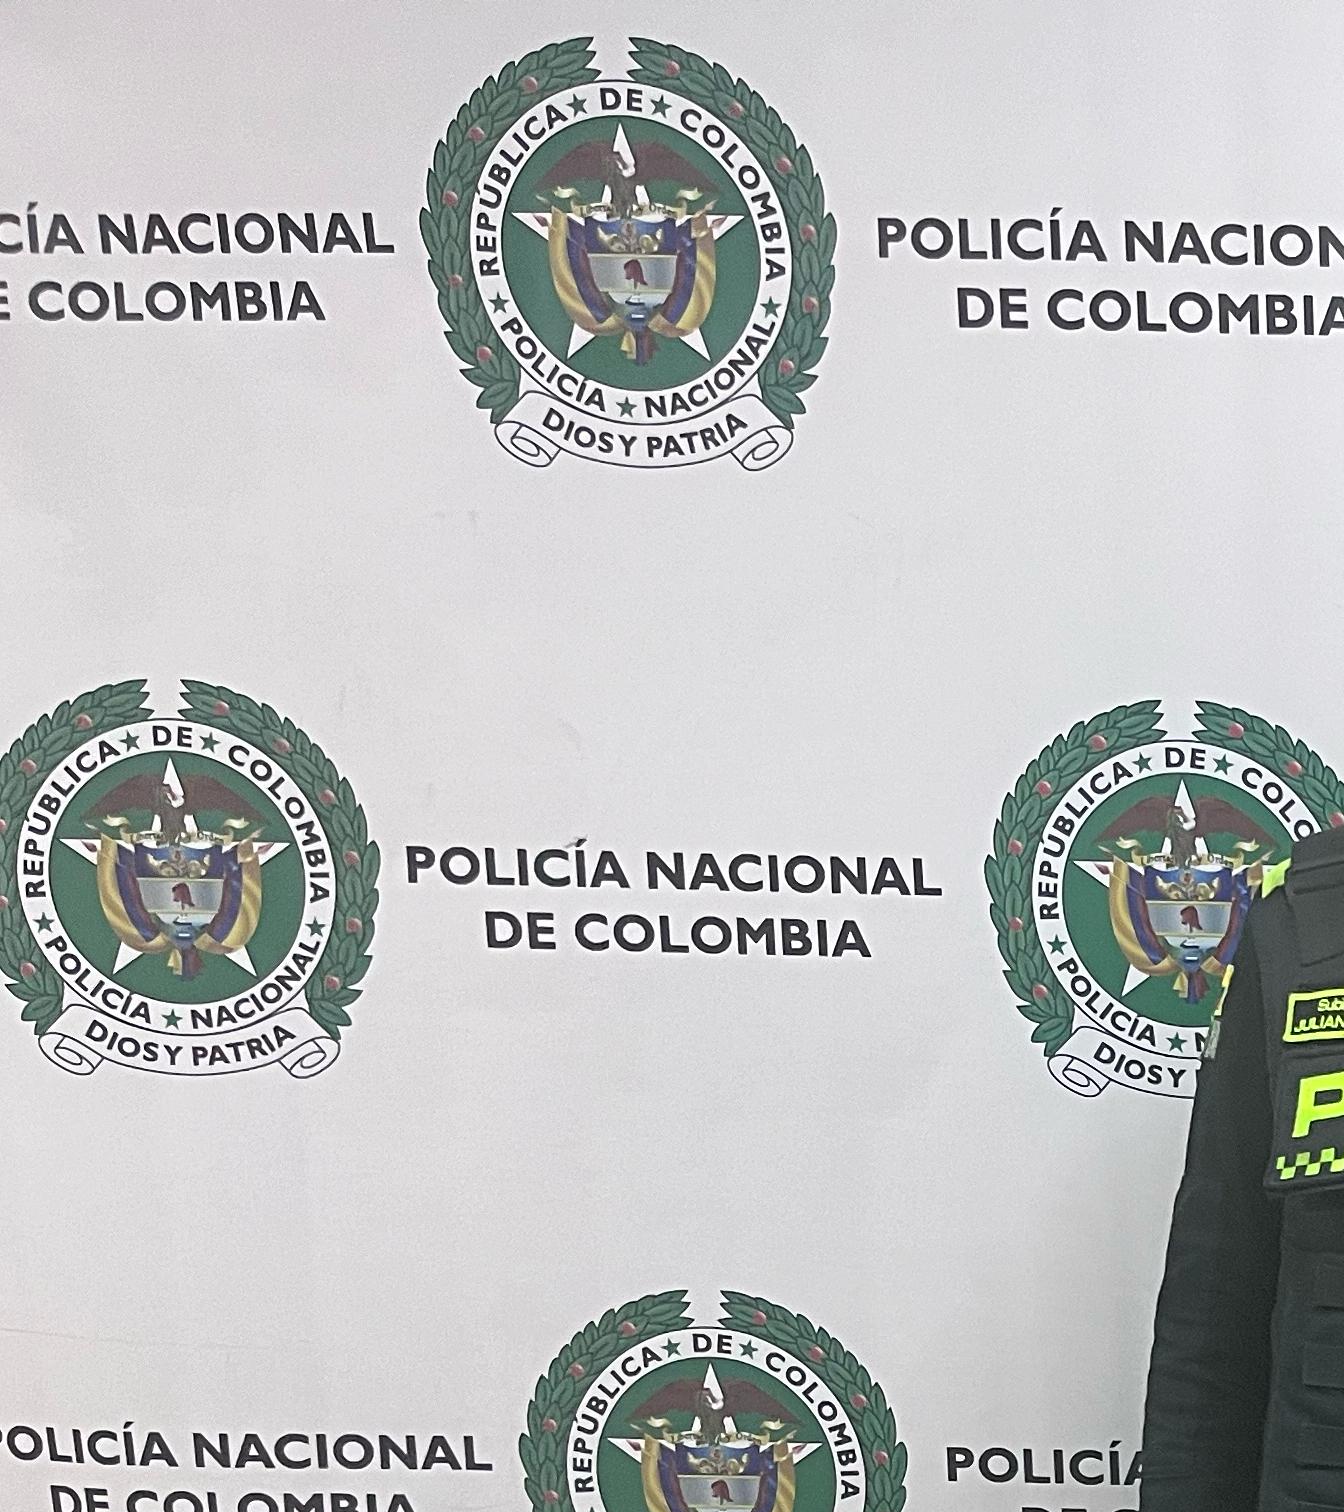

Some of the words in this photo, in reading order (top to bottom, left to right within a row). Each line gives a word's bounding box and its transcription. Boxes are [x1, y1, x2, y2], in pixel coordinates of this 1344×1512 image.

[599, 87, 643, 113] DE
[680, 108, 786, 282] COLOMBIA
[98, 212, 394, 254] NACIONAL
[878, 207, 1107, 262] POLICÍA
[28, 281, 326, 321] COLOMBIA
[957, 288, 1028, 329] DE
[644, 321, 776, 418] NACIONAL
[646, 413, 748, 458] PATRIA
[150, 726, 193, 750] DE
[228, 746, 331, 903] COLOMBIA
[1164, 746, 1207, 771] DE
[1241, 767, 1321, 842] COLO
[406, 838, 630, 888] POLICÍA
[647, 852, 942, 896] NACIONAL
[485, 911, 556, 949] DE
[575, 913, 871, 957] COLOMBIA
[190, 939, 321, 1030] NACIONAL
[191, 1025, 294, 1068] PATRIA
[691, 1333, 732, 1356] DE
[765, 1352, 861, 1500] COLOMBIA
[0, 1421, 178, 1467] OLICÍA
[193, 1433, 492, 1471] NACIONAL
